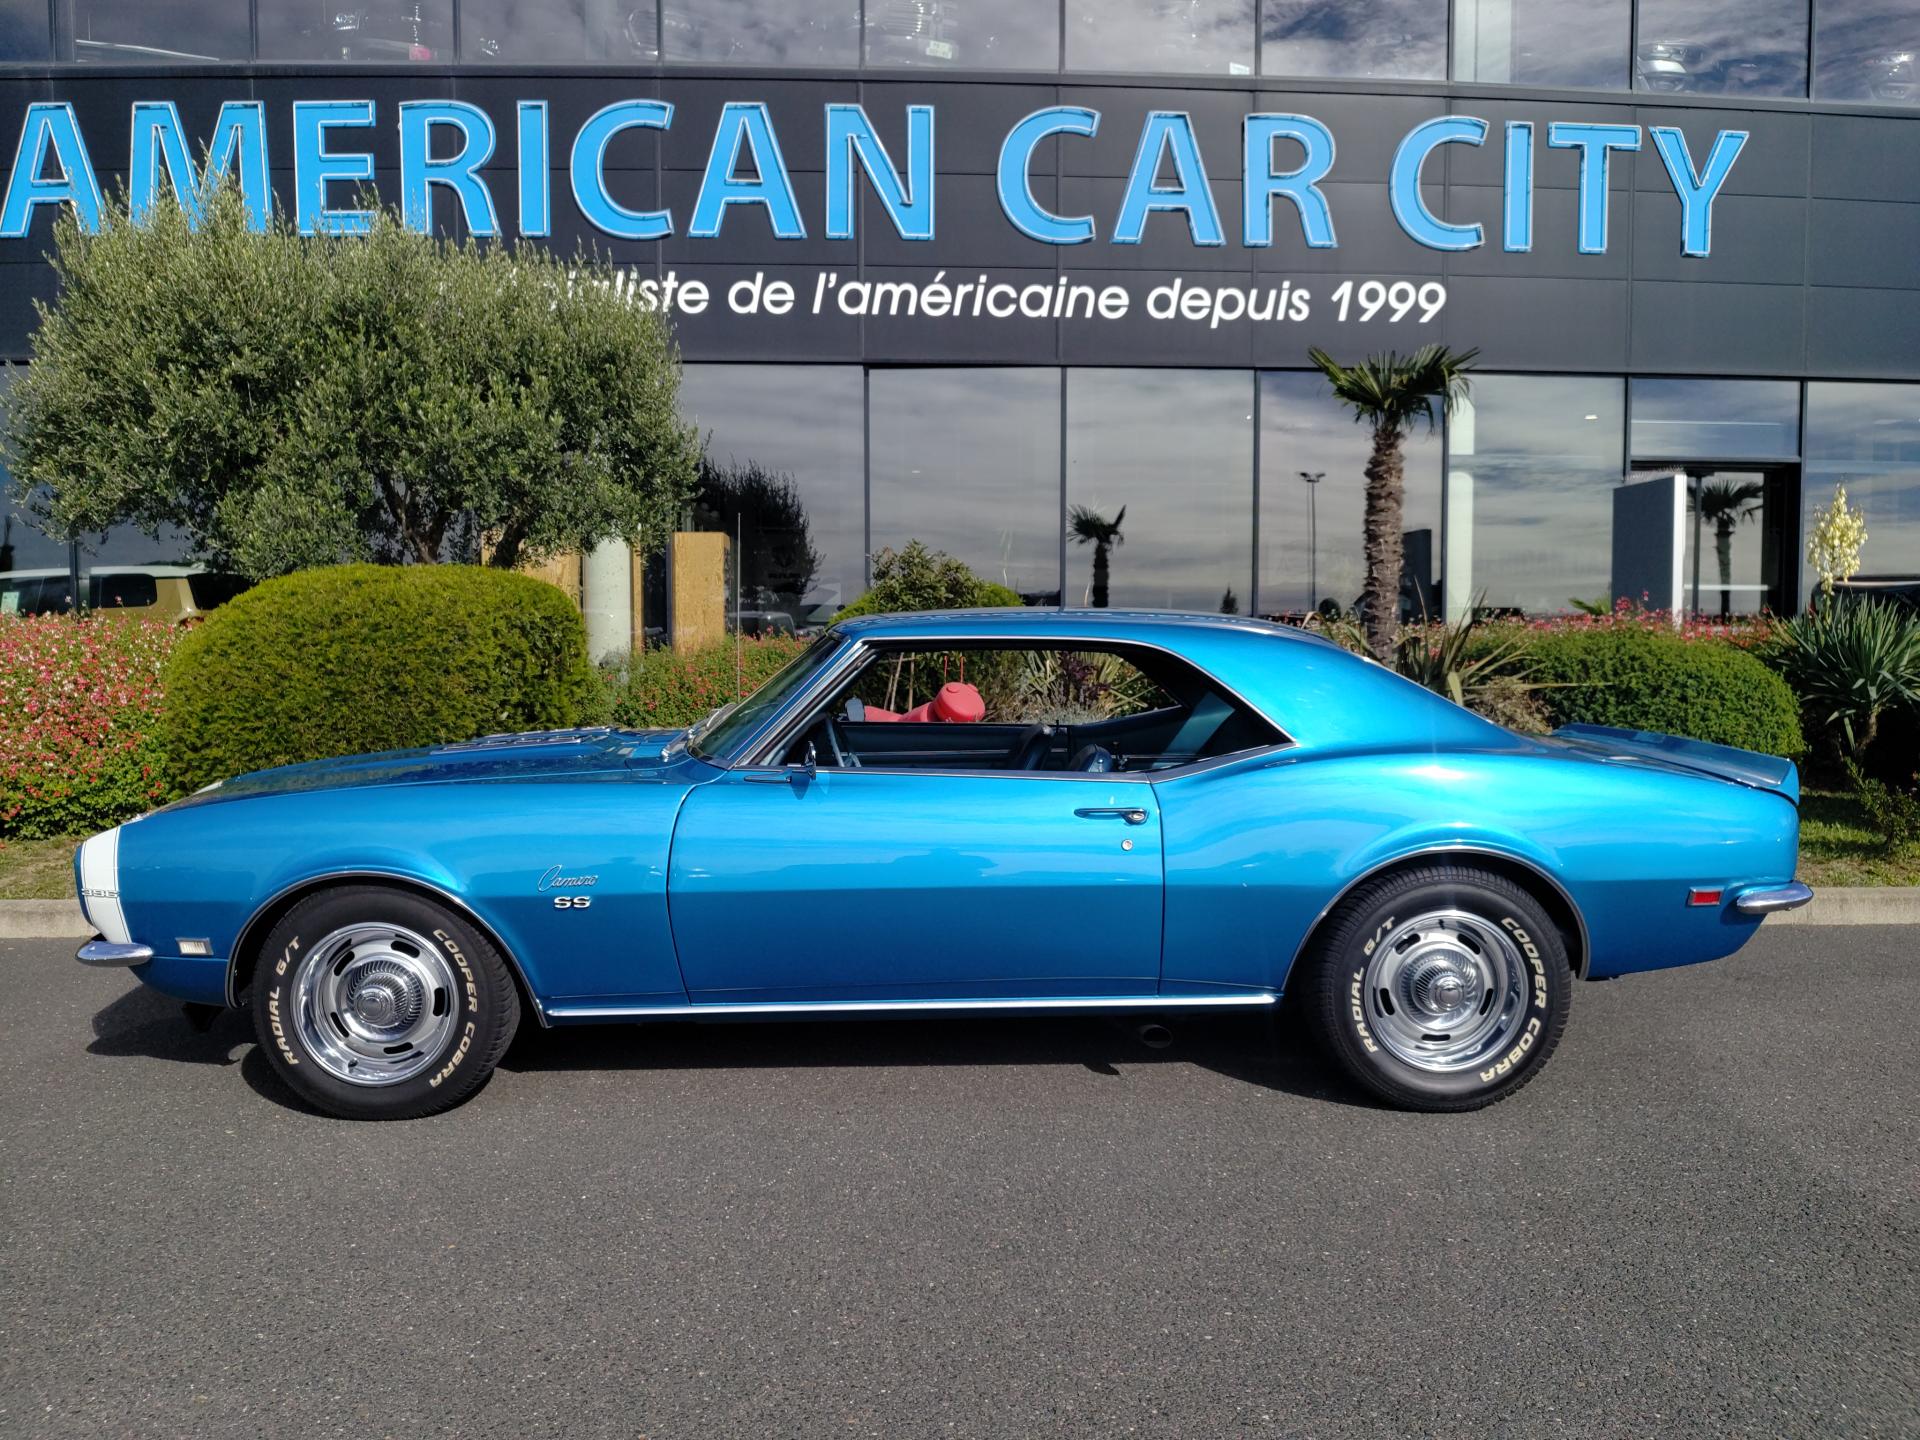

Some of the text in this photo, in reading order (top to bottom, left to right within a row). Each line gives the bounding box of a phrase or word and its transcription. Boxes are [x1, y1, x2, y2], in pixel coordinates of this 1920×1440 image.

[0, 99, 1750, 258] AMERICAN CAR CITY
[727, 271, 795, 315] de
[812, 270, 1130, 320] l'américaine
[1146, 277, 1312, 329] depuis
[1331, 280, 1447, 324] 1999
[538, 864, 599, 892] Camaro
[554, 896, 591, 909] SS
[269, 935, 300, 1065] RADIAL G/T
[428, 928, 478, 1089] COOPER COBRA
[1351, 916, 1395, 1053] RADIAL G/T
[1479, 917, 1547, 1083] COOPER COBRA
